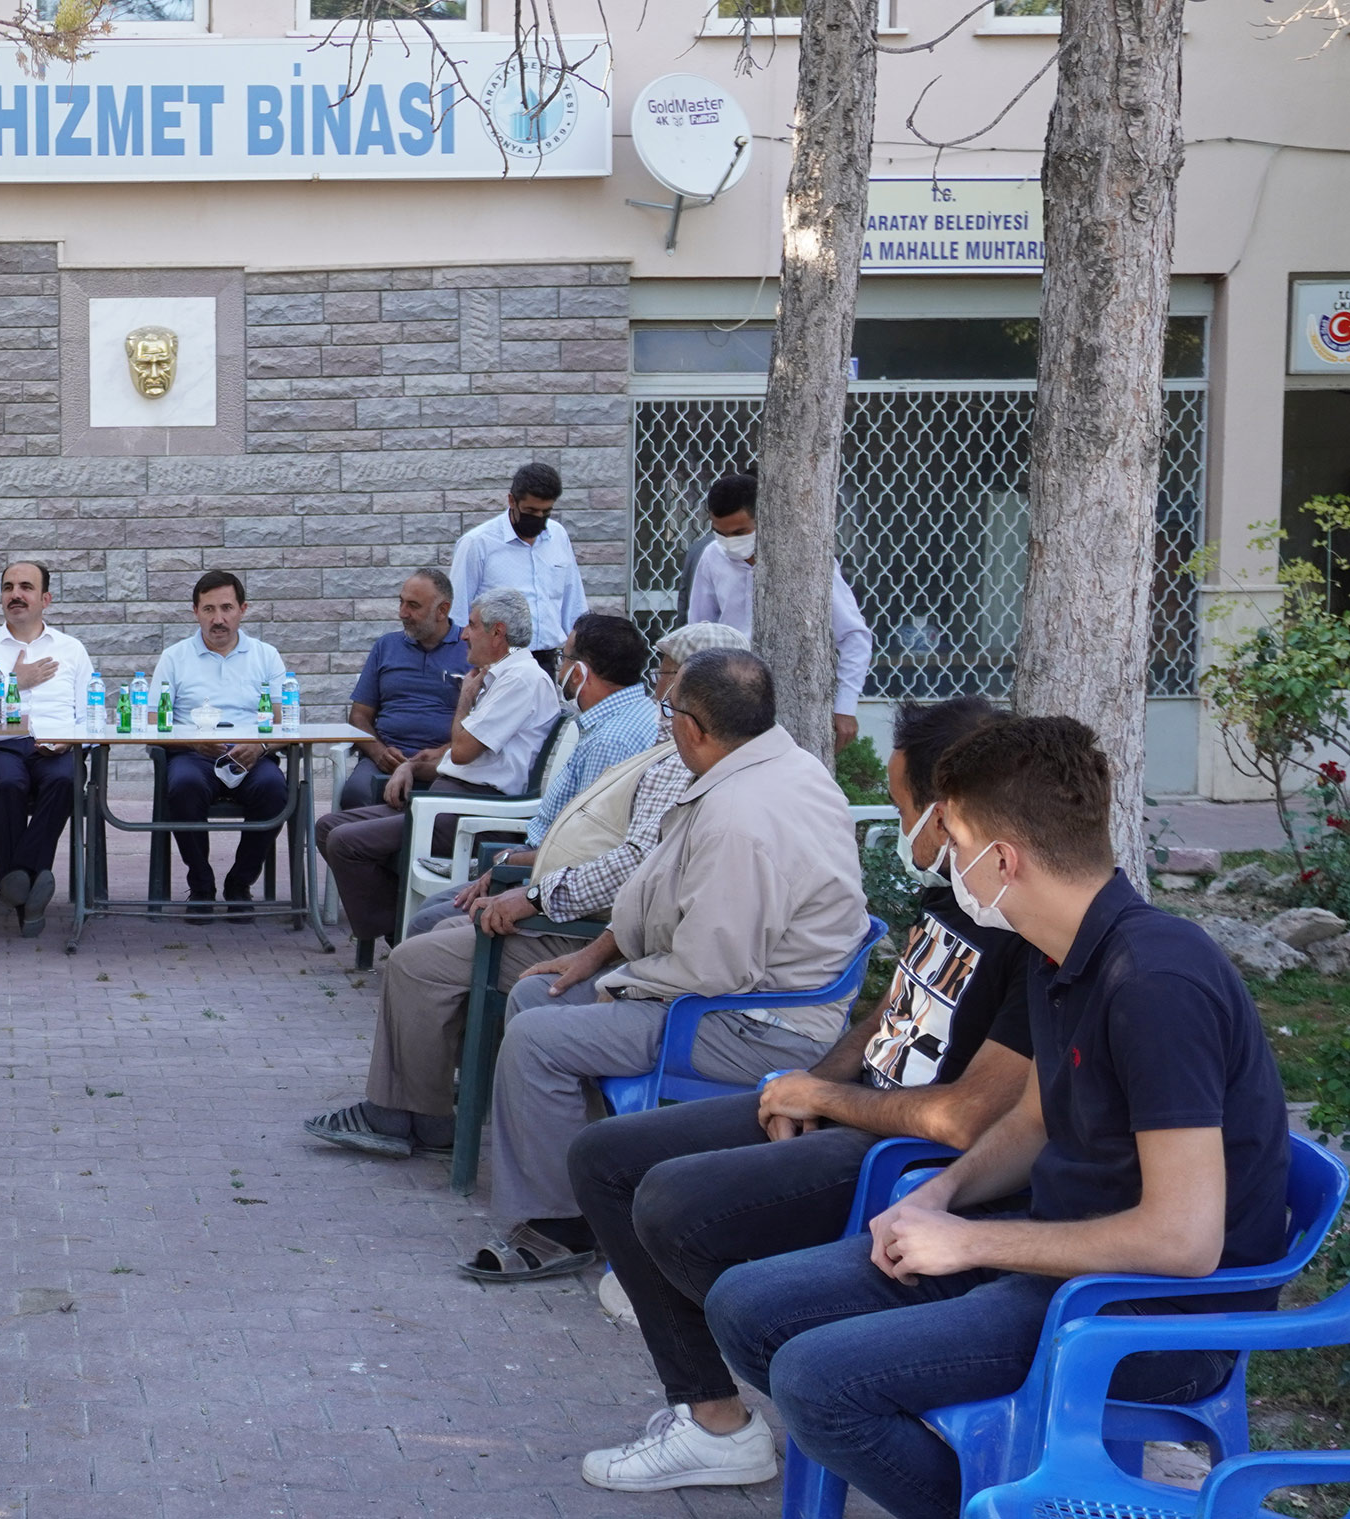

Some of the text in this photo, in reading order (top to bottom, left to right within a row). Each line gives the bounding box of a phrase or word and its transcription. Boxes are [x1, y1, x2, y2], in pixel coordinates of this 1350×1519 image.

[247, 62, 455, 156] BİNASI
[647, 97, 724, 113] GoldMaster
[656, 115, 669, 126] 4K
[934, 211, 1028, 230] BELEDİYESİ
[879, 241, 959, 260] MAHALLE
